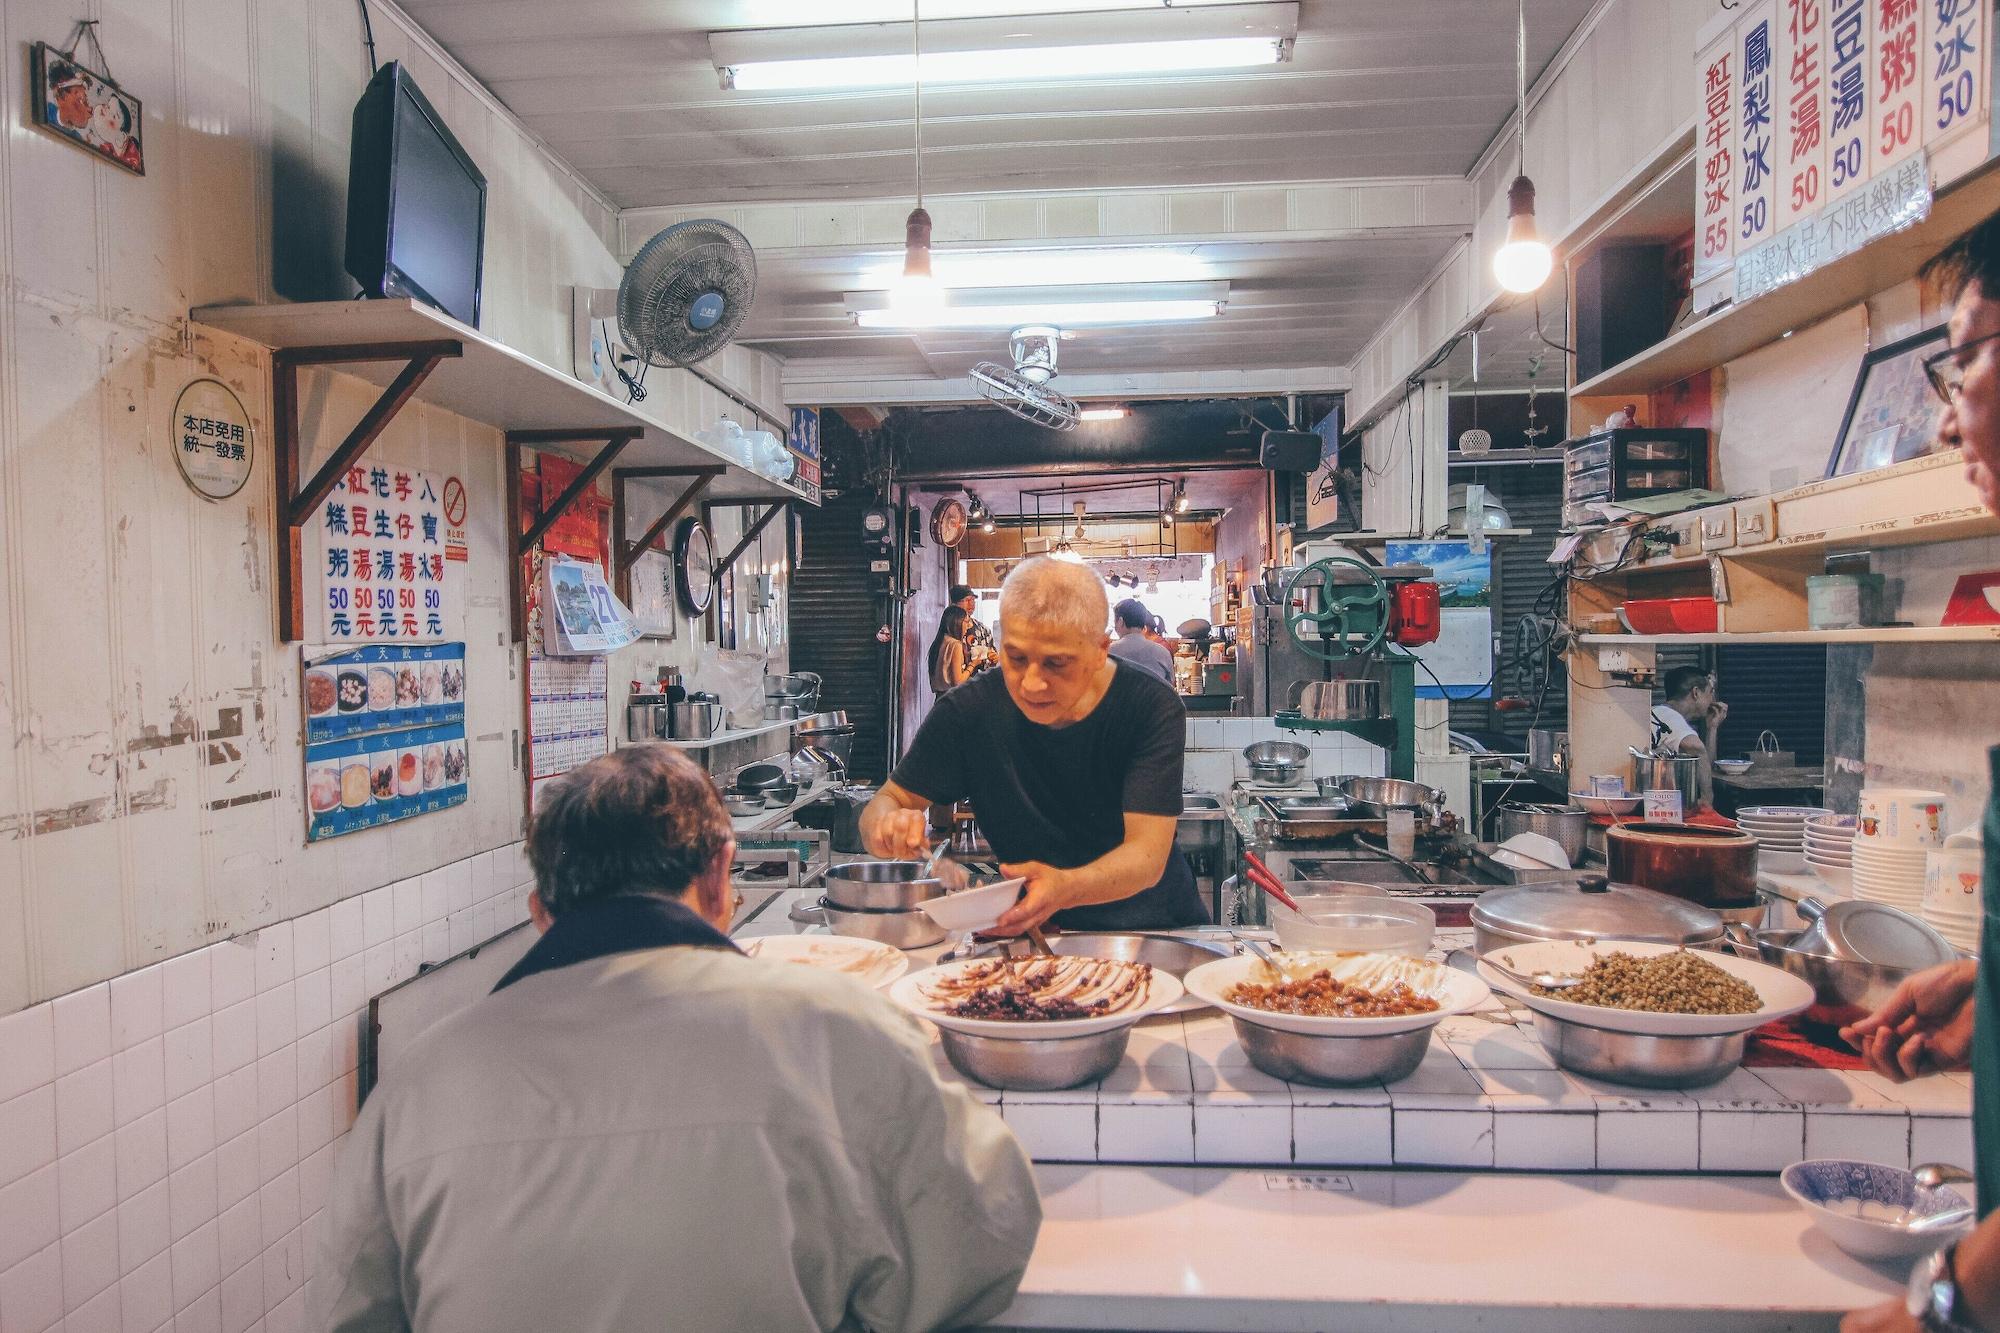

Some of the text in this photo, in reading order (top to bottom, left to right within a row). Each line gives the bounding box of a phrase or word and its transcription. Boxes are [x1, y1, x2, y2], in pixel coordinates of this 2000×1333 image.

[1831, 0, 1865, 187] 豆湯 50
[1937, 69, 1973, 129] 50
[1741, 19, 1771, 240] 鳳梨冰 50
[1880, 101, 1913, 156] 50
[1704, 52, 1731, 258] 紅豆牛奶冰 55
[1791, 164, 1818, 212] 50
[183, 414, 244, 443] 本店免用
[183, 433, 245, 461] 統一發票
[348, 466, 375, 637] 紅豆湯 50 元
[370, 466, 398, 637] 花生湯 50 元
[395, 471, 419, 636] 芋仔湯 50 元
[329, 587, 349, 609] 50
[424, 588, 440, 609] 50
[589, 585, 619, 624] 27
[331, 612, 351, 636] 元
[427, 613, 442, 636] 元
